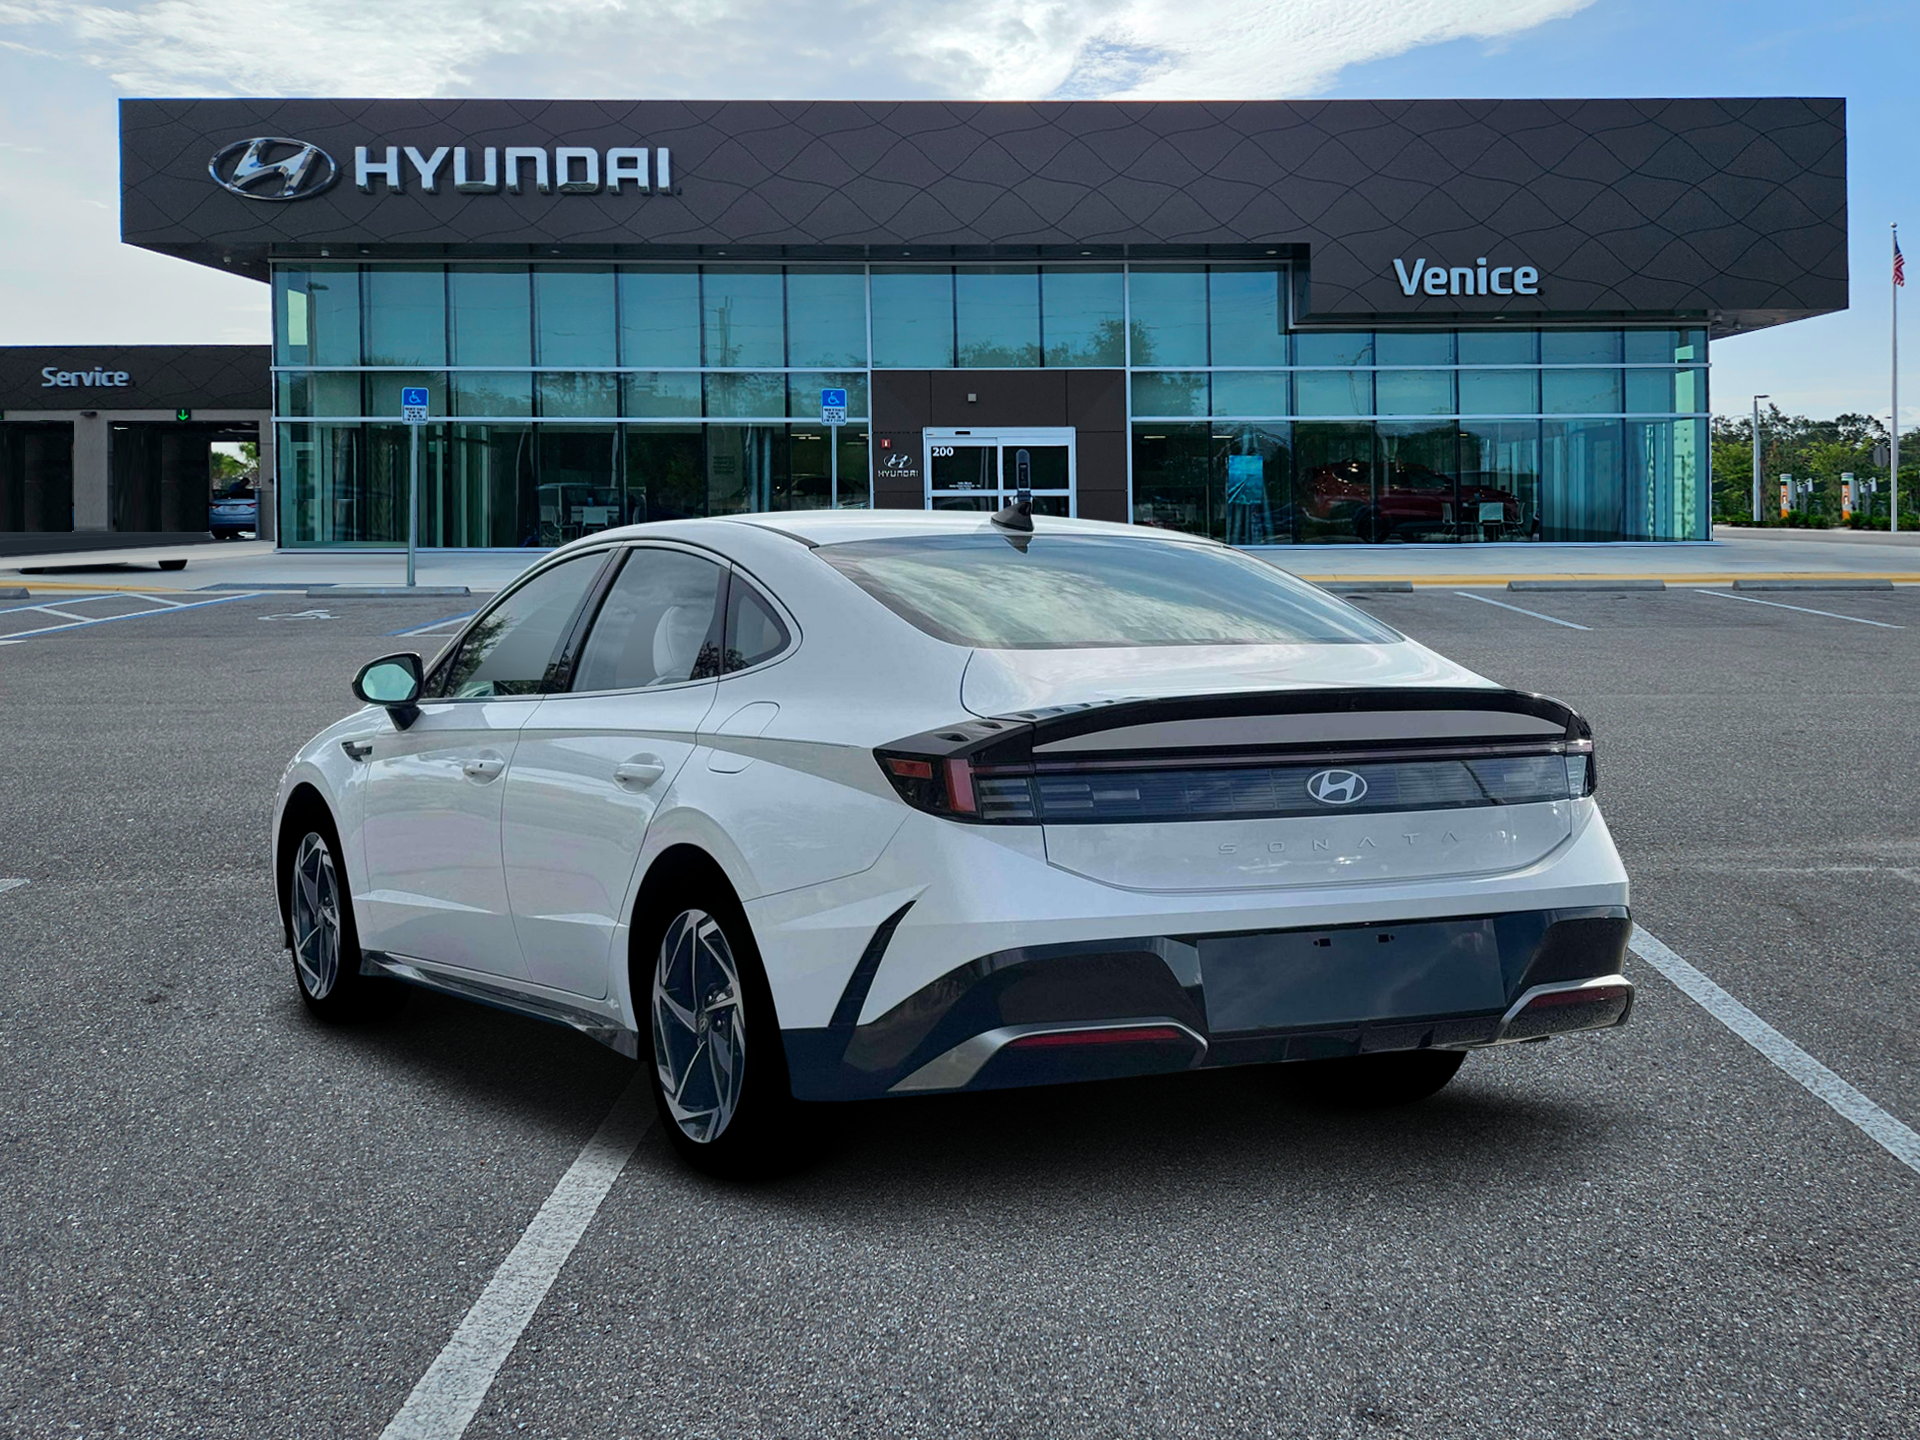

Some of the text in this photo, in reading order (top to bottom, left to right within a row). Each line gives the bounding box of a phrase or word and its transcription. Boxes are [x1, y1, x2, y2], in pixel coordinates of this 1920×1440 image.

[355, 146, 673, 194] HYUNDAI
[1393, 257, 1539, 296] Venice
[41, 367, 130, 387] Service
[932, 446, 954, 457] 200
[877, 469, 919, 478] HYUNDAI
